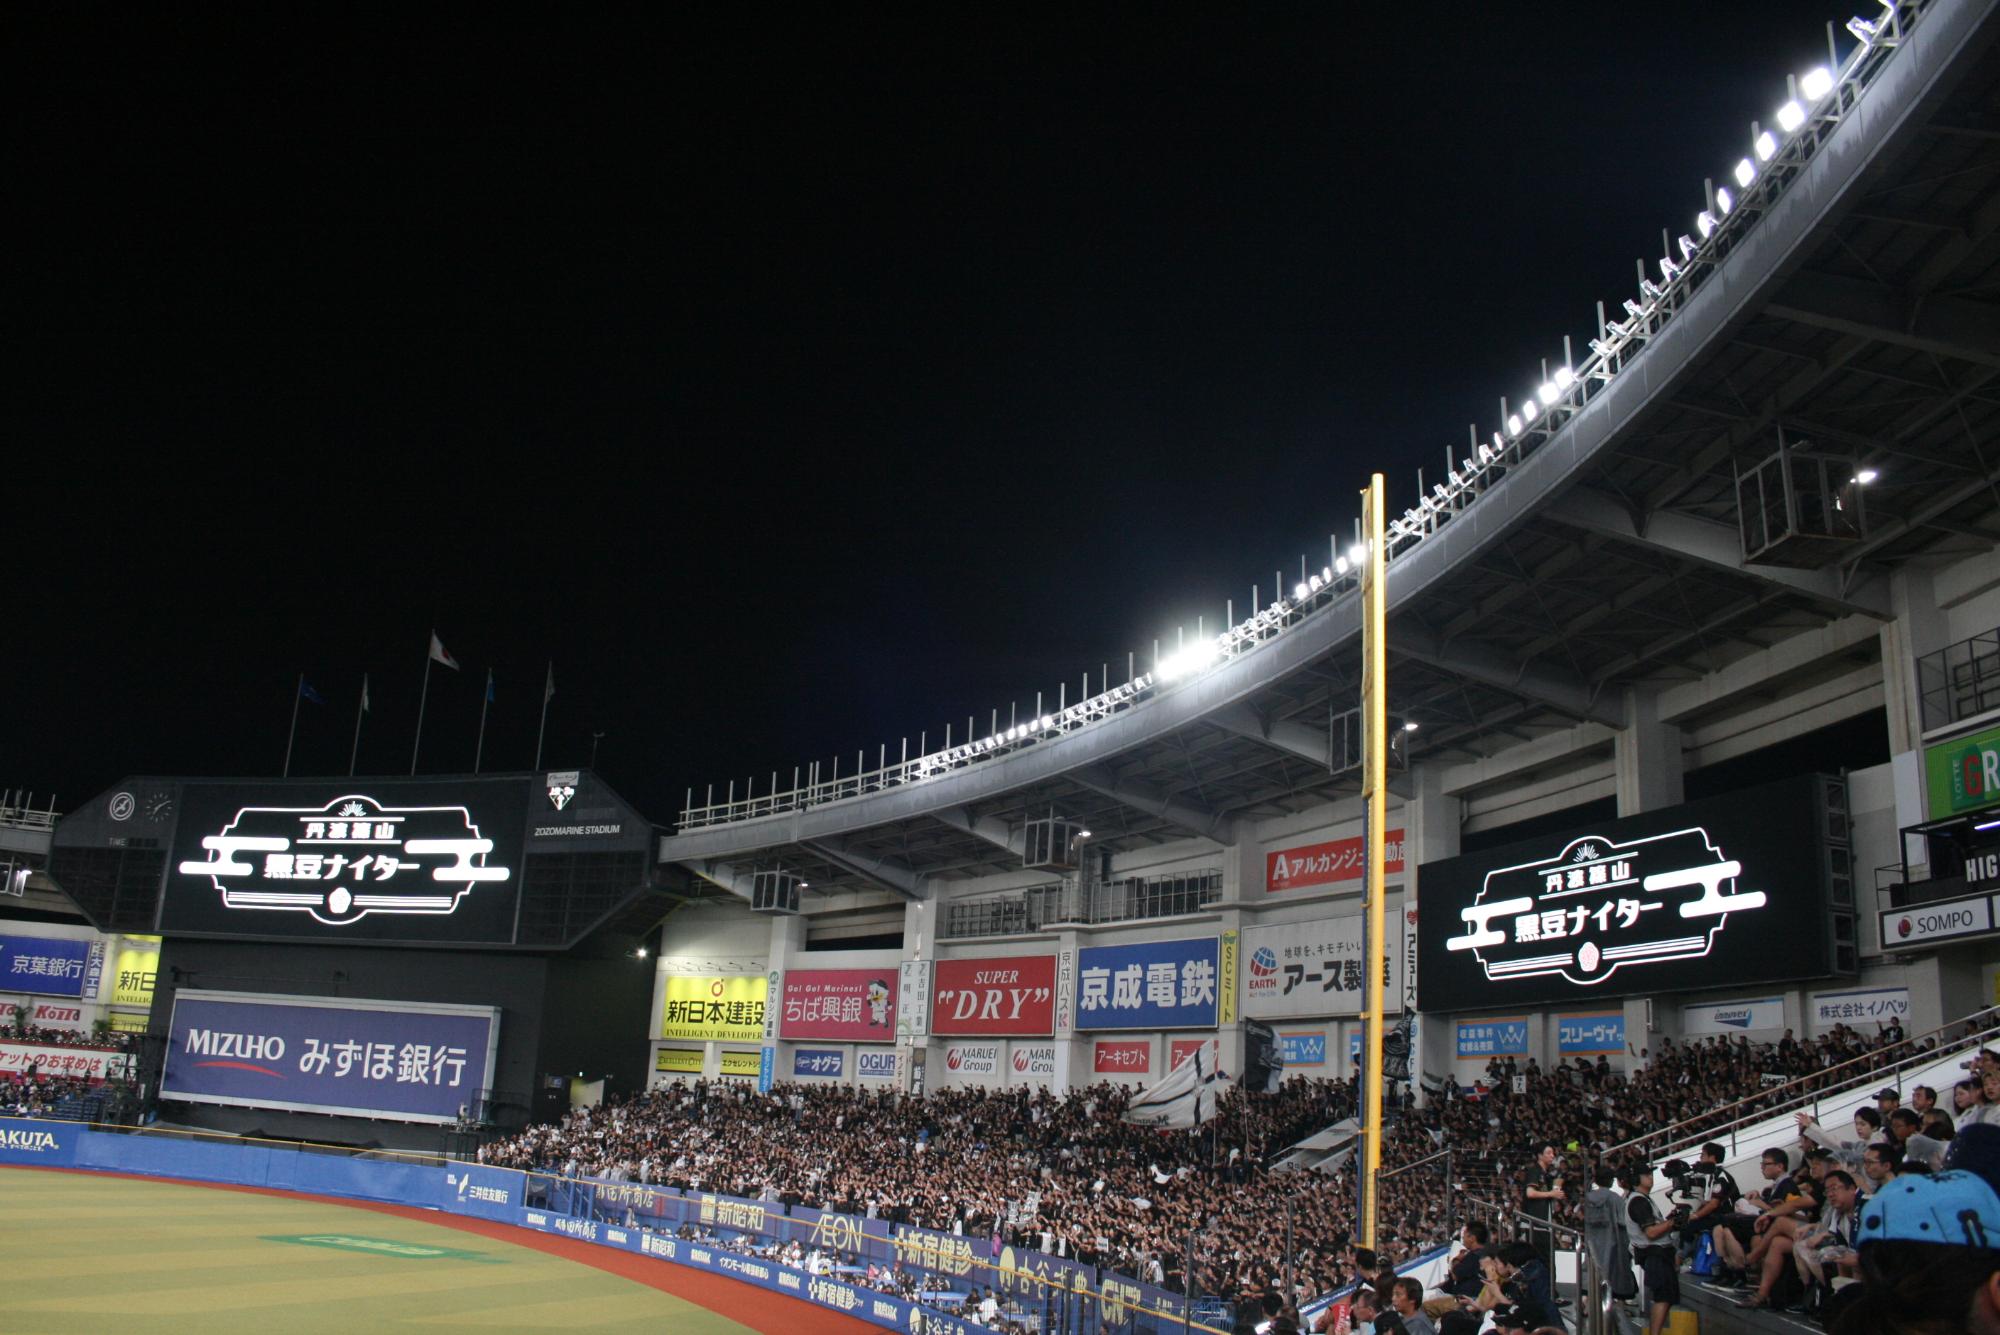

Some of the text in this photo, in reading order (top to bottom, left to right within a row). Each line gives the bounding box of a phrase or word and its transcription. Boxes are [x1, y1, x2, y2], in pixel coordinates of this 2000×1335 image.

[585, 824, 621, 835] STADIUM
[264, 853, 420, 881] 黒豆ナイター
[1514, 898, 1665, 944] 黒豆ナイター
[1917, 909, 1973, 934] SOMPO
[10, 954, 84, 979] 京葉銀行
[974, 970, 1019, 985] SUPER
[1405, 933, 1417, 1001] アミューズ
[787, 983, 863, 993] Go! Go! Marines!
[1059, 951, 1072, 1011] 京成バス
[1080, 959, 1215, 1011] 京成電鉄
[1249, 978, 1277, 990] EARTH
[667, 1000, 765, 1026] 新日本建設
[785, 995, 863, 1023] ちば興銀
[1820, 1003, 1865, 1019] 株式会社
[185, 1028, 286, 1060] MIZUHO
[666, 1028, 763, 1040] INTELLIGENT DEVELOPER
[299, 1038, 467, 1087] みずほ銀行
[721, 1059, 761, 1069] エクセレントシ
[810, 1055, 842, 1073] オグラ
[961, 1047, 998, 1059] MARUEI
[1097, 1048, 1147, 1066] アーキセプト
[963, 1060, 992, 1073] Group
[717, 1199, 765, 1231] 新昭和
[651, 1236, 676, 1259] 新昭和
